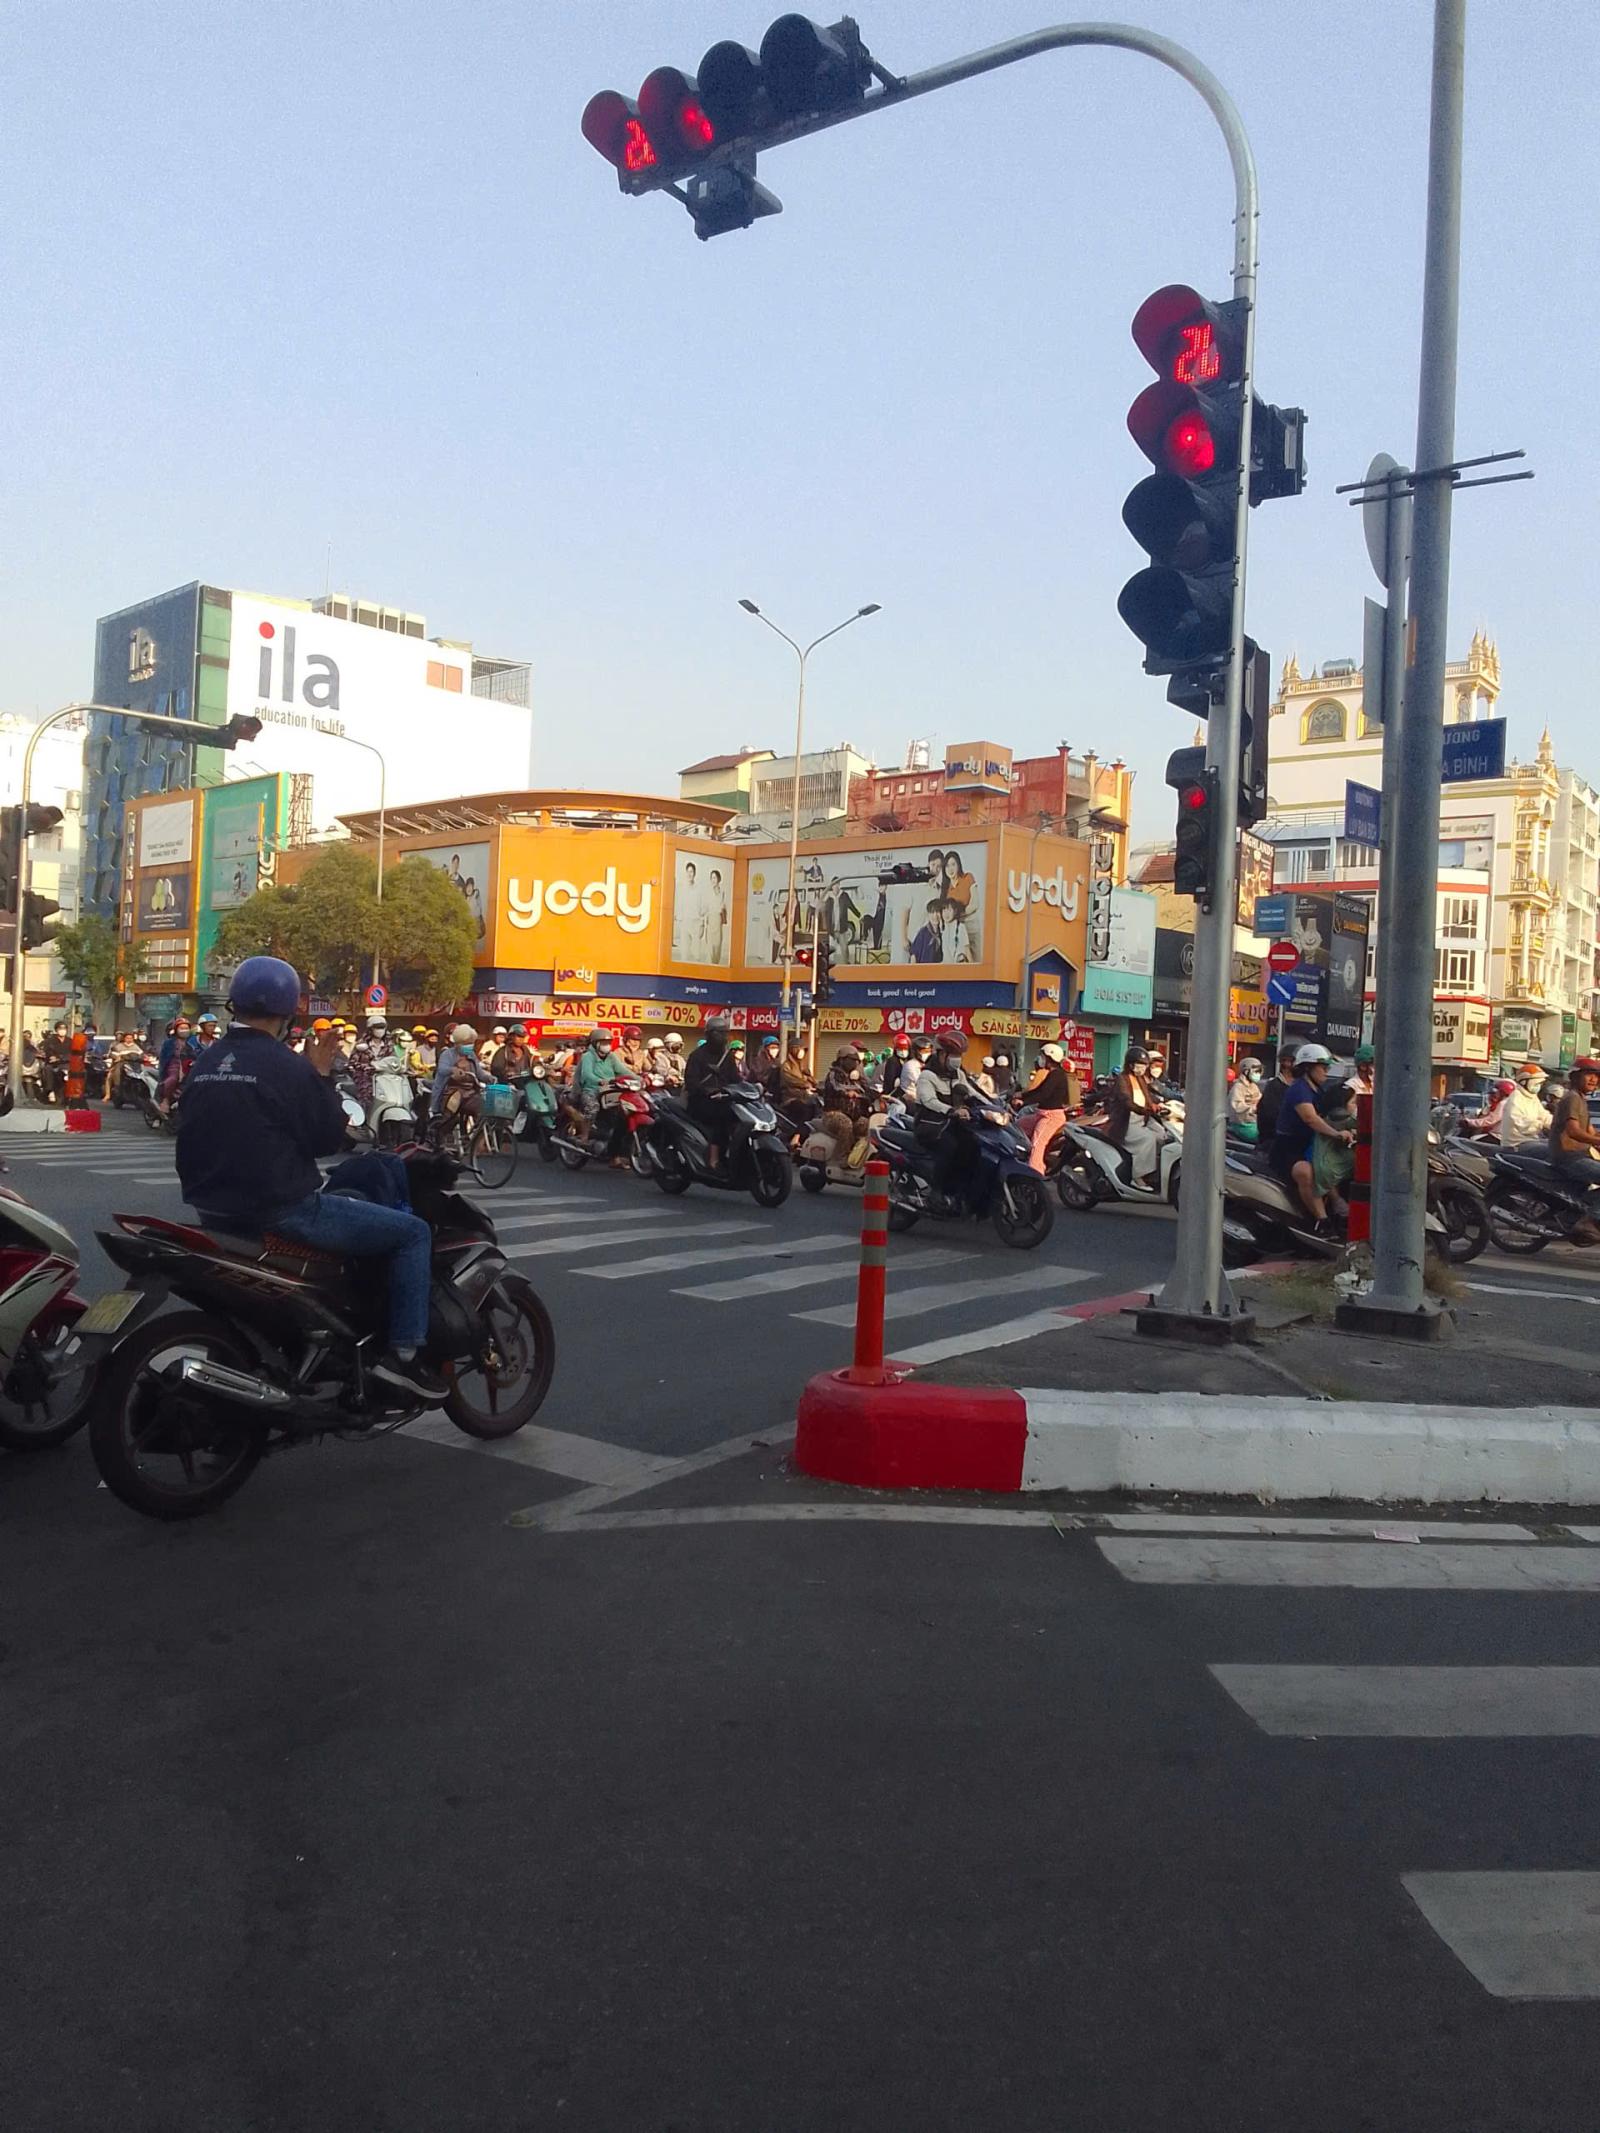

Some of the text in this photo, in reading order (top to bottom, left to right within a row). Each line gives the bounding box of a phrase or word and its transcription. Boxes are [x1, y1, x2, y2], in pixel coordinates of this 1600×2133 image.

[258, 621, 340, 711] ila
[255, 706, 307, 728] education
[329, 717, 345, 736] life
[508, 866, 651, 933] yody
[1008, 866, 1078, 921] yody
[557, 965, 594, 983] yody
[596, 1004, 642, 1019] SALE
[664, 1006, 695, 1023] 70%
[752, 1010, 778, 1027] yody
[931, 1011, 962, 1030] yody
[845, 1018, 869, 1030] 70%
[1031, 1024, 1050, 1038] 70%
